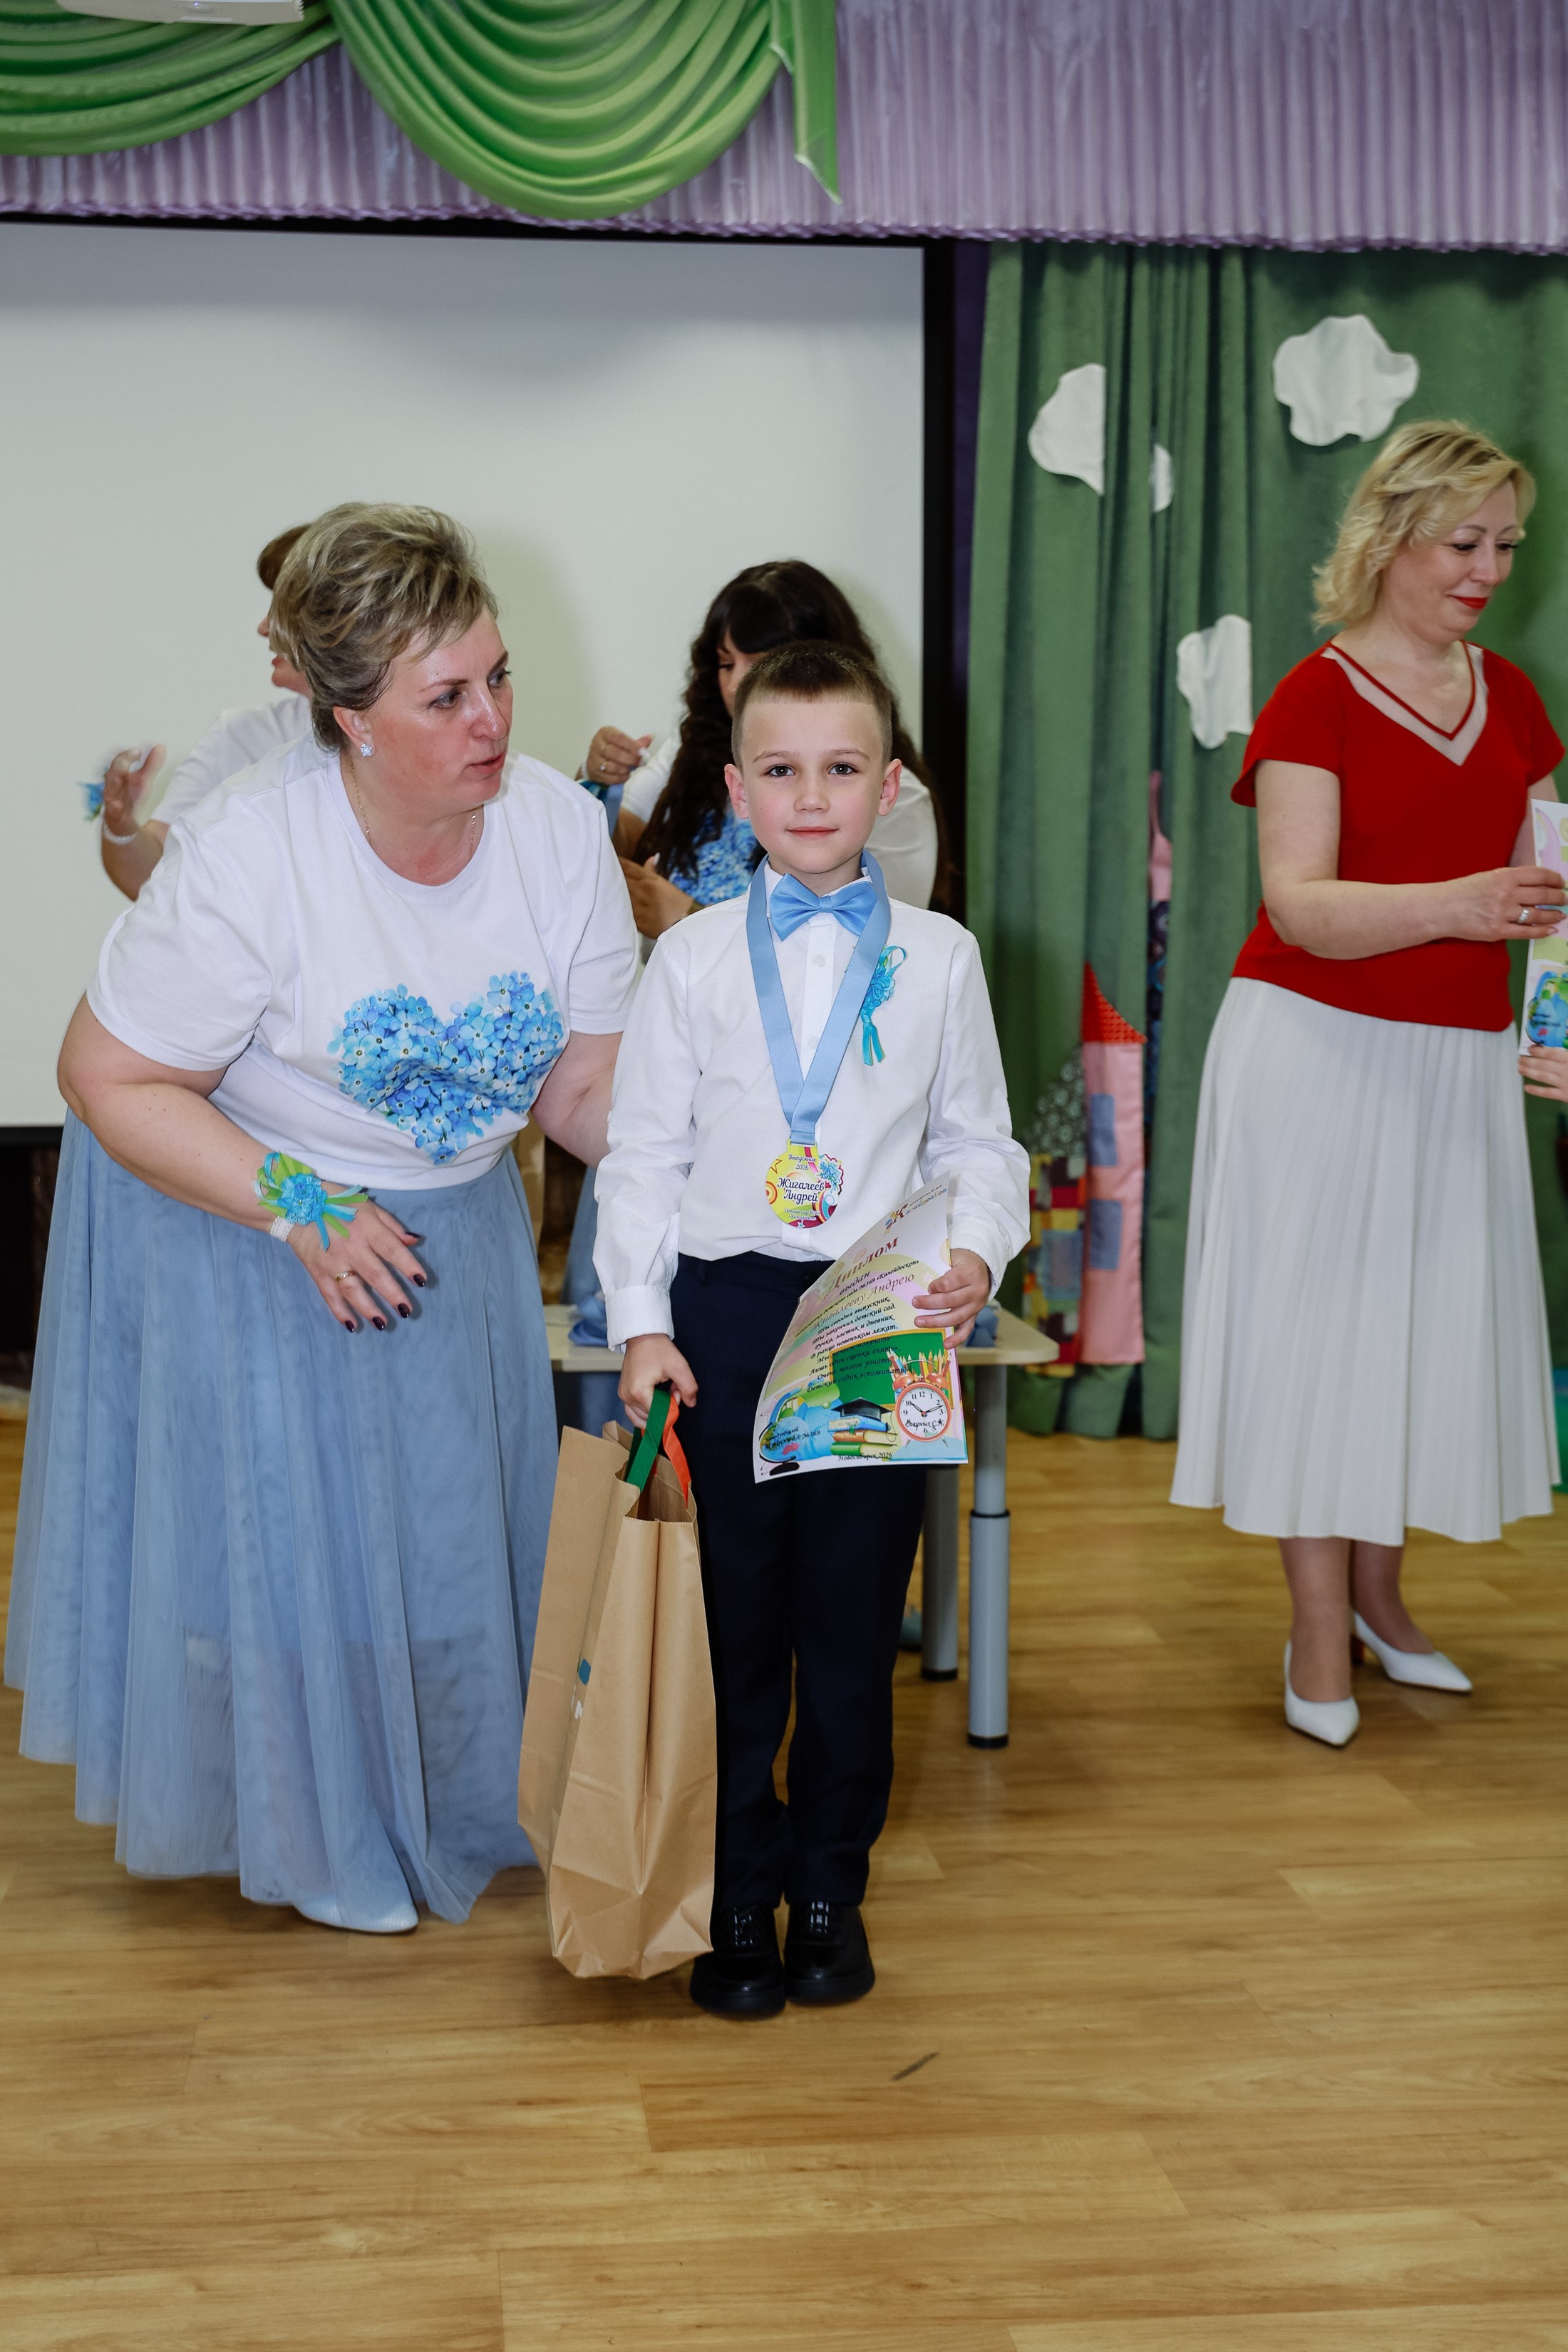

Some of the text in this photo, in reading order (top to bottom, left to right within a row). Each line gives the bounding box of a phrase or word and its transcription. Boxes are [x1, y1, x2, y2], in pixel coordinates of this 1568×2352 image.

[777, 1177, 825, 1191] Жигалеев
[784, 1190, 818, 1205] Андрей
[823, 1237, 898, 1299] Диплом
[877, 1260, 919, 1279] «Калейдоскоп»
[840, 1272, 870, 1295] выдан
[867, 1274, 914, 1299] Андрею
[825, 1320, 853, 1337] закончил
[855, 1308, 882, 1323] детский
[883, 1303, 896, 1311] сад.
[831, 1311, 853, 1326] сегодня
[855, 1296, 890, 1314] выпускник,
[814, 1338, 834, 1350] Ручка,
[835, 1325, 860, 1339] ластик
[866, 1314, 895, 1326] дневник
[816, 1345, 835, 1358] ранце
[836, 1331, 870, 1347] новеньком
[872, 1324, 897, 1335] лежат.
[809, 1365, 828, 1376] Лишь
[846, 1351, 870, 1362] оценки
[840, 1363, 863, 1373] многое
[806, 1380, 837, 1393] Детский
